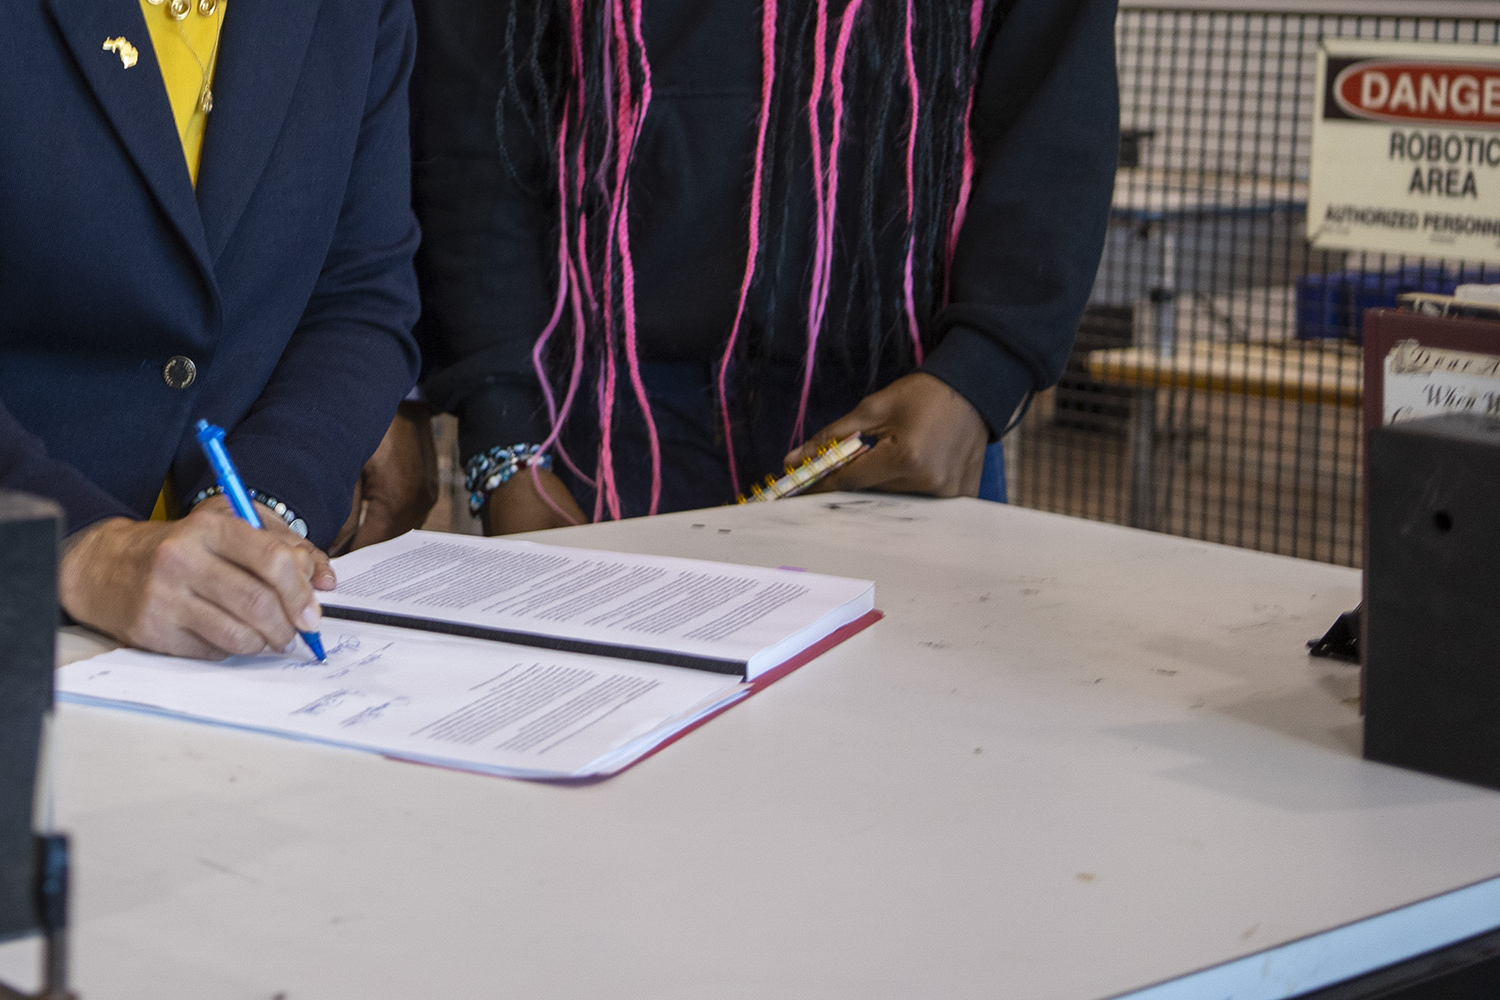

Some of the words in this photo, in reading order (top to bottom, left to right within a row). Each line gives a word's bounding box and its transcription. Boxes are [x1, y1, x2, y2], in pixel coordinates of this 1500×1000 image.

[1389, 130, 1500, 168] ROBOTIC
[1409, 167, 1478, 199] AREA
[1325, 203, 1420, 230] AUTHORIZED
[1423, 211, 1500, 236] PERSONN
[1422, 383, 1477, 410] When
